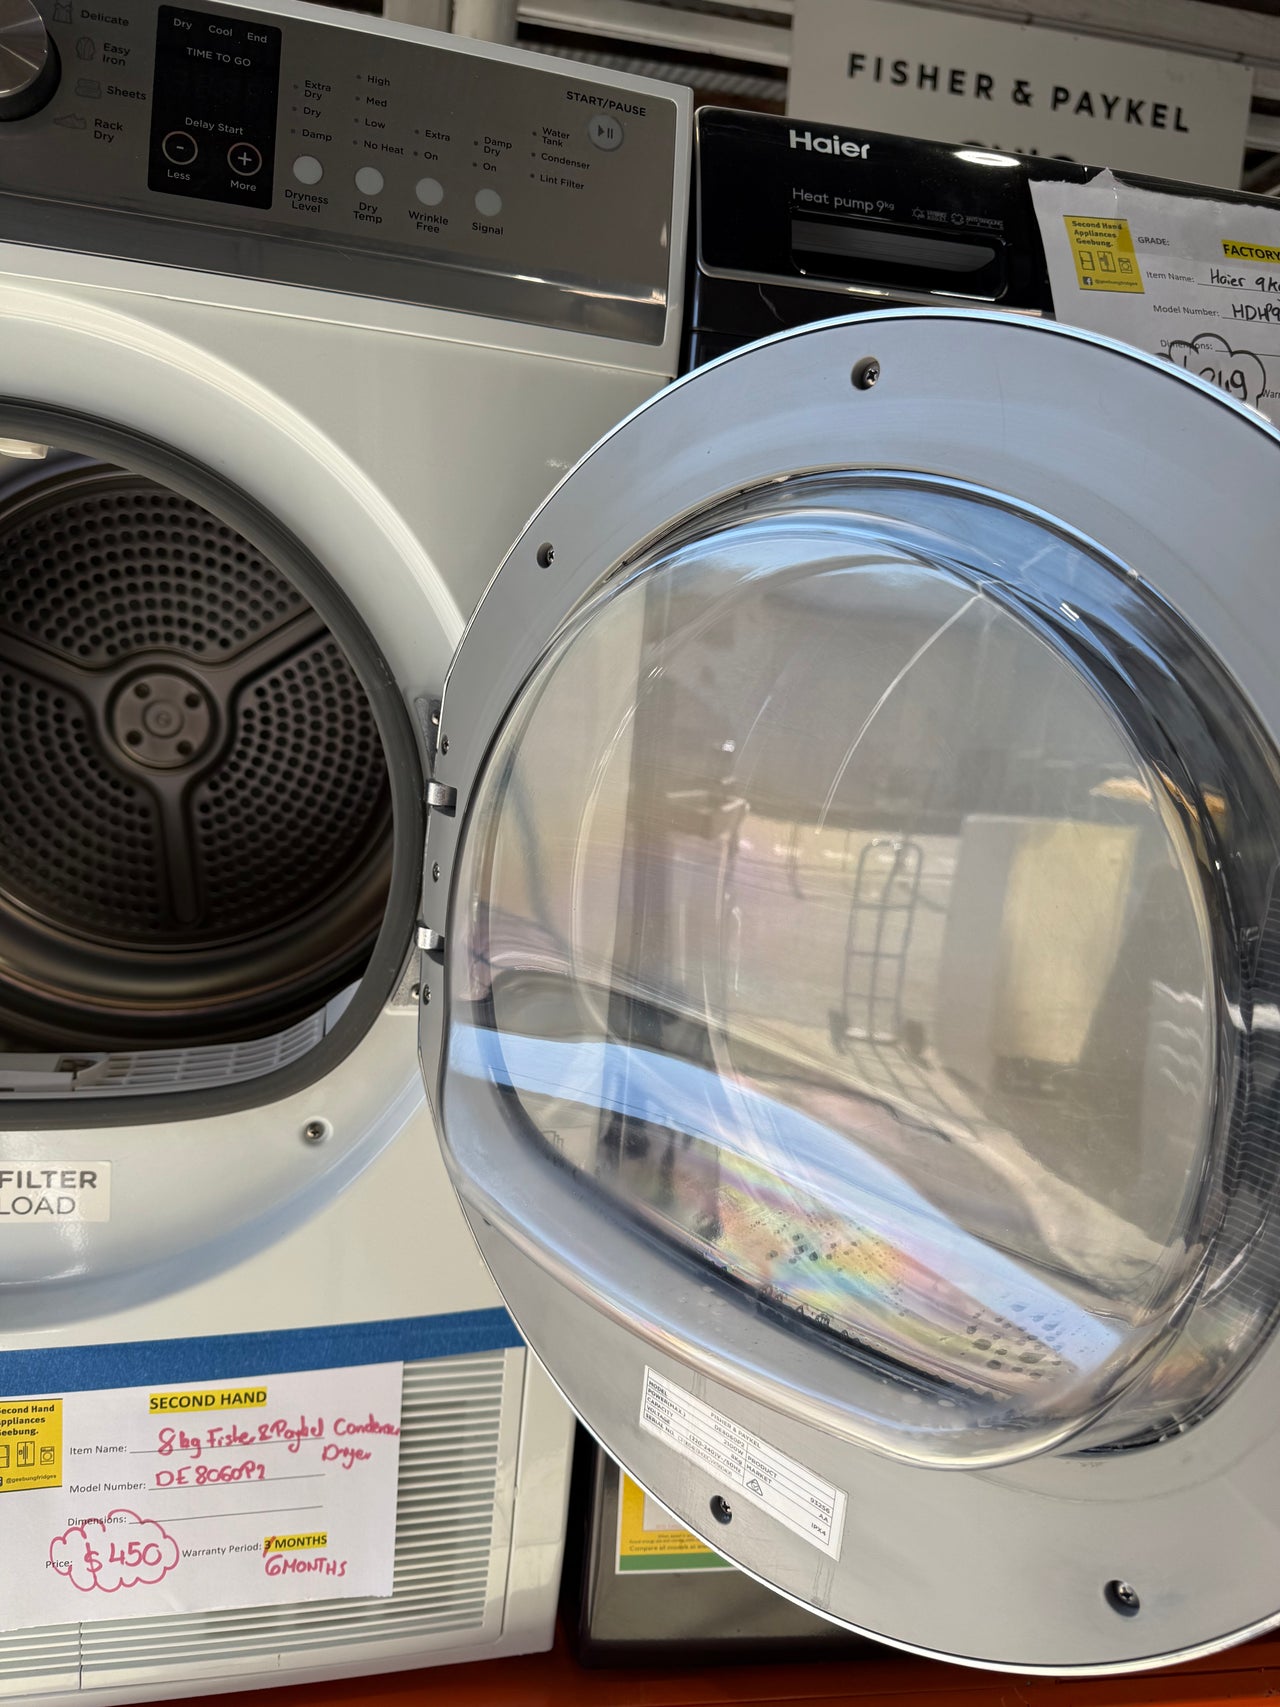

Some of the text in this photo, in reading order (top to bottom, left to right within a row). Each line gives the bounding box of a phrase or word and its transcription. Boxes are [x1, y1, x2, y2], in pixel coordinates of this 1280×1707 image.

[81, 9, 129, 26] Delicate
[173, 18, 193, 31] Dry
[208, 25, 233, 37] Cool
[247, 32, 268, 44] End
[103, 42, 131, 56] Easy
[102, 54, 126, 66] Iron
[186, 46, 251, 67] TIME TO GO
[304, 79, 332, 92] Extra
[367, 75, 391, 87] High
[106, 85, 147, 101] Sheets
[303, 89, 323, 101] Dry
[846, 53, 1191, 132] FISHER & PAYKEL
[366, 96, 388, 107] Med
[566, 90, 647, 117] START/PAUSE
[303, 106, 321, 118] Dry
[94, 118, 124, 132] Rack
[185, 117, 244, 136] Delay Start
[365, 118, 386, 129] Low
[93, 130, 115, 143] Dry
[302, 129, 333, 142] Damp
[425, 129, 451, 142] Extra
[542, 126, 570, 139] Water
[363, 140, 404, 155] No Heat
[484, 136, 513, 150] Damp
[541, 136, 563, 148] Tank
[789, 129, 870, 160] Haier
[424, 151, 438, 161] On
[483, 146, 501, 157] Dry
[483, 162, 497, 172] On
[541, 152, 590, 170] Condenser
[167, 169, 191, 181] Less
[230, 180, 257, 192] More
[540, 174, 585, 190] Lint Filter
[284, 189, 329, 205] Dryness
[792, 187, 895, 213] Heat pump 9kg
[291, 201, 321, 213] Level
[358, 201, 378, 214] Dry
[353, 211, 383, 224] Temp
[408, 210, 449, 226] Wrinkle
[416, 222, 440, 233] Free
[471, 222, 504, 236] Signal
[1072, 221, 1122, 230] Second Hand
[1074, 229, 1117, 238] Appliances
[1137, 236, 1170, 247] GRADE:
[1222, 243, 1280, 260] FACTORY
[1146, 271, 1166, 280] Item
[1167, 272, 1195, 283] Name:
[1210, 267, 1246, 287] Haier
[1153, 304, 1181, 315] Model
[1183, 306, 1220, 317] Number:
[0, 1170, 97, 1189] FILTER
[648, 1380, 668, 1396] MODEL
[149, 1391, 267, 1410] SECOND HAND
[31, 1404, 55, 1413] Hand
[646, 1405, 671, 1424] VOLTAGE
[0, 1417, 46, 1427] ppliances
[645, 1413, 664, 1429] SERIAL
[710, 1412, 732, 1428] FISHER
[738, 1430, 761, 1448] PAYKEL
[69, 1446, 93, 1455] Item
[95, 1445, 127, 1454] Name:
[646, 1396, 674, 1418] CAPACITY
[746, 1464, 773, 1484] MARKET
[818, 1513, 829, 1523] AA
[747, 1455, 777, 1478] PRODUCT
[69, 1484, 101, 1493] Model
[103, 1482, 146, 1492] Number:
[67, 1515, 127, 1526] Dimensions:
[810, 1522, 827, 1536] IPX4
[182, 1546, 226, 1558] Warranty
[229, 1543, 262, 1553] Period:
[275, 1534, 328, 1549] MONTHS
[45, 1559, 73, 1569] Price:
